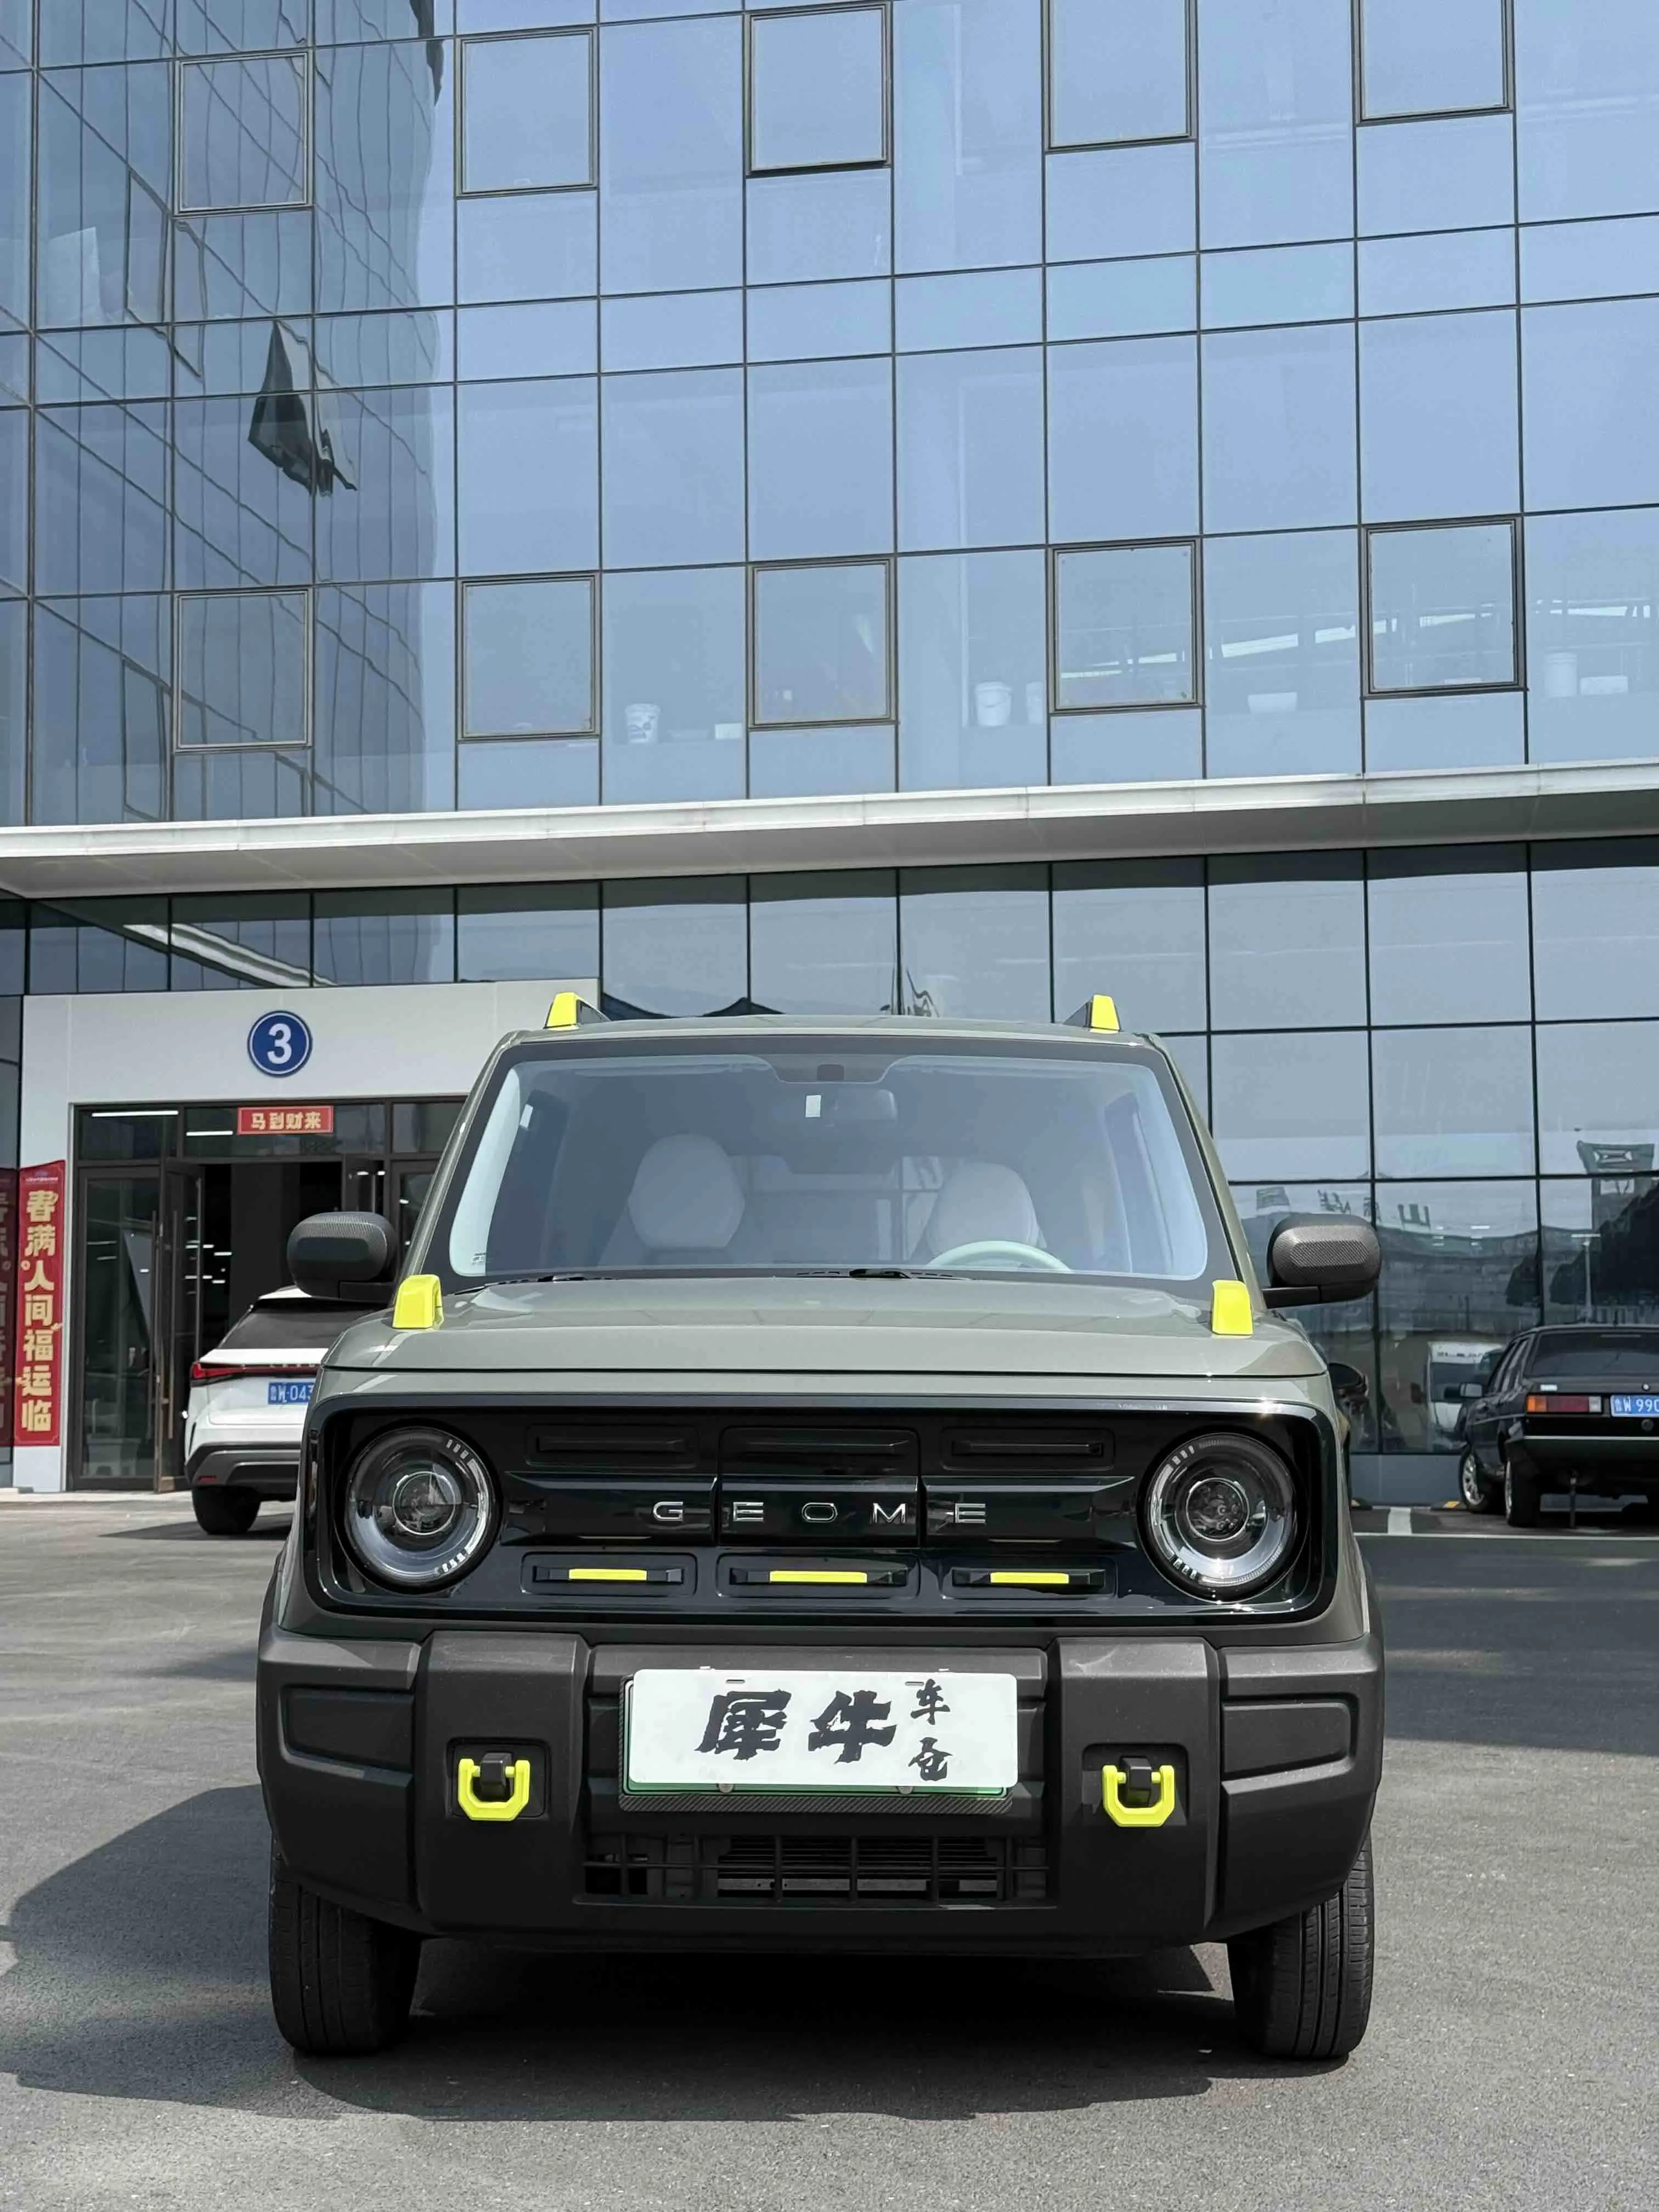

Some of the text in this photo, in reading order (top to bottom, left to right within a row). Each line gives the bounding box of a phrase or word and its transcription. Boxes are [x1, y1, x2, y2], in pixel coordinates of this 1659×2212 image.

[267, 1023, 292, 1064] 3
[251, 1111, 321, 1131] 马到财来
[22, 1190, 59, 1431] 春满人间福运临
[653, 1500, 986, 1524] GEOME
